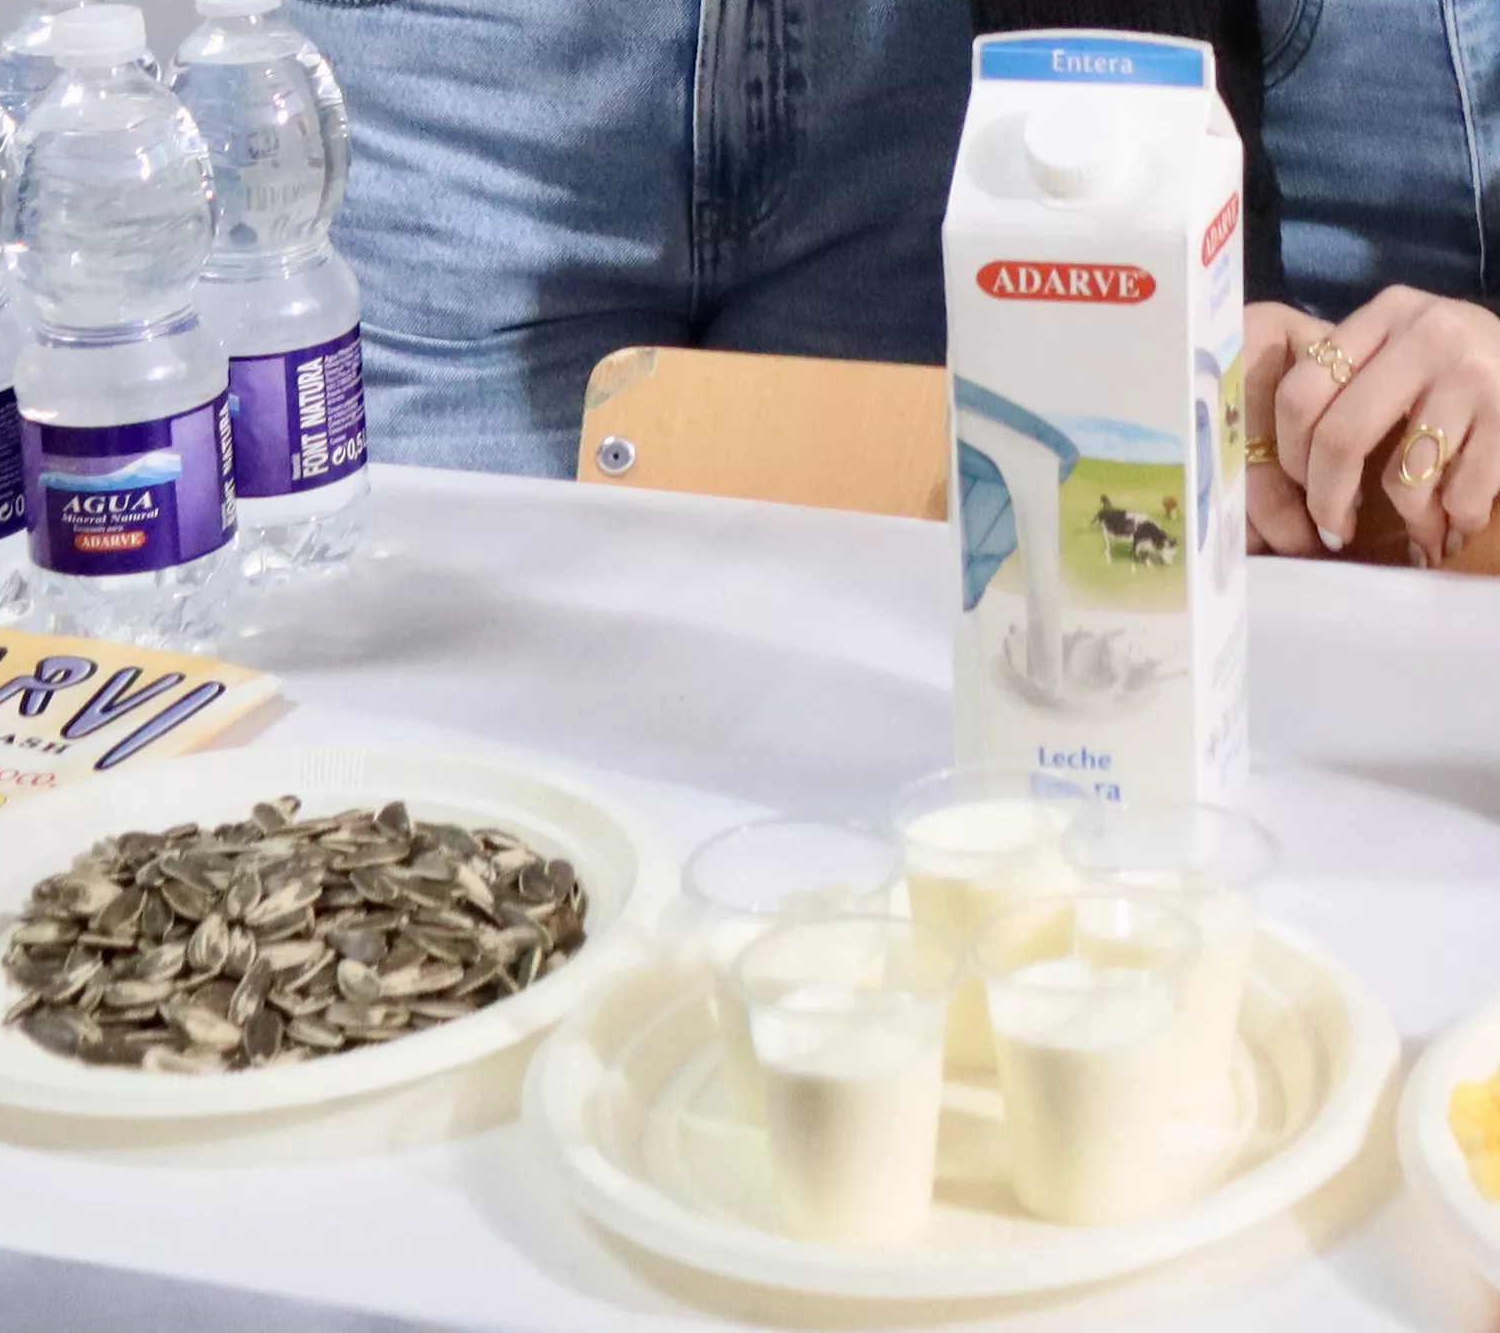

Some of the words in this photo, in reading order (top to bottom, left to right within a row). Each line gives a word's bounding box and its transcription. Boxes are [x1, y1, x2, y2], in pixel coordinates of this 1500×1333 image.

[1052, 48, 1134, 77] Entera
[992, 266, 1141, 299] ADARVE
[297, 356, 326, 430] NATURA
[301, 431, 329, 479] FONT
[62, 490, 153, 514] AGUA
[61, 510, 107, 525] Mineral
[111, 508, 159, 524] Natural
[80, 532, 142, 549] ADARVE
[1037, 745, 1112, 771] Leche
